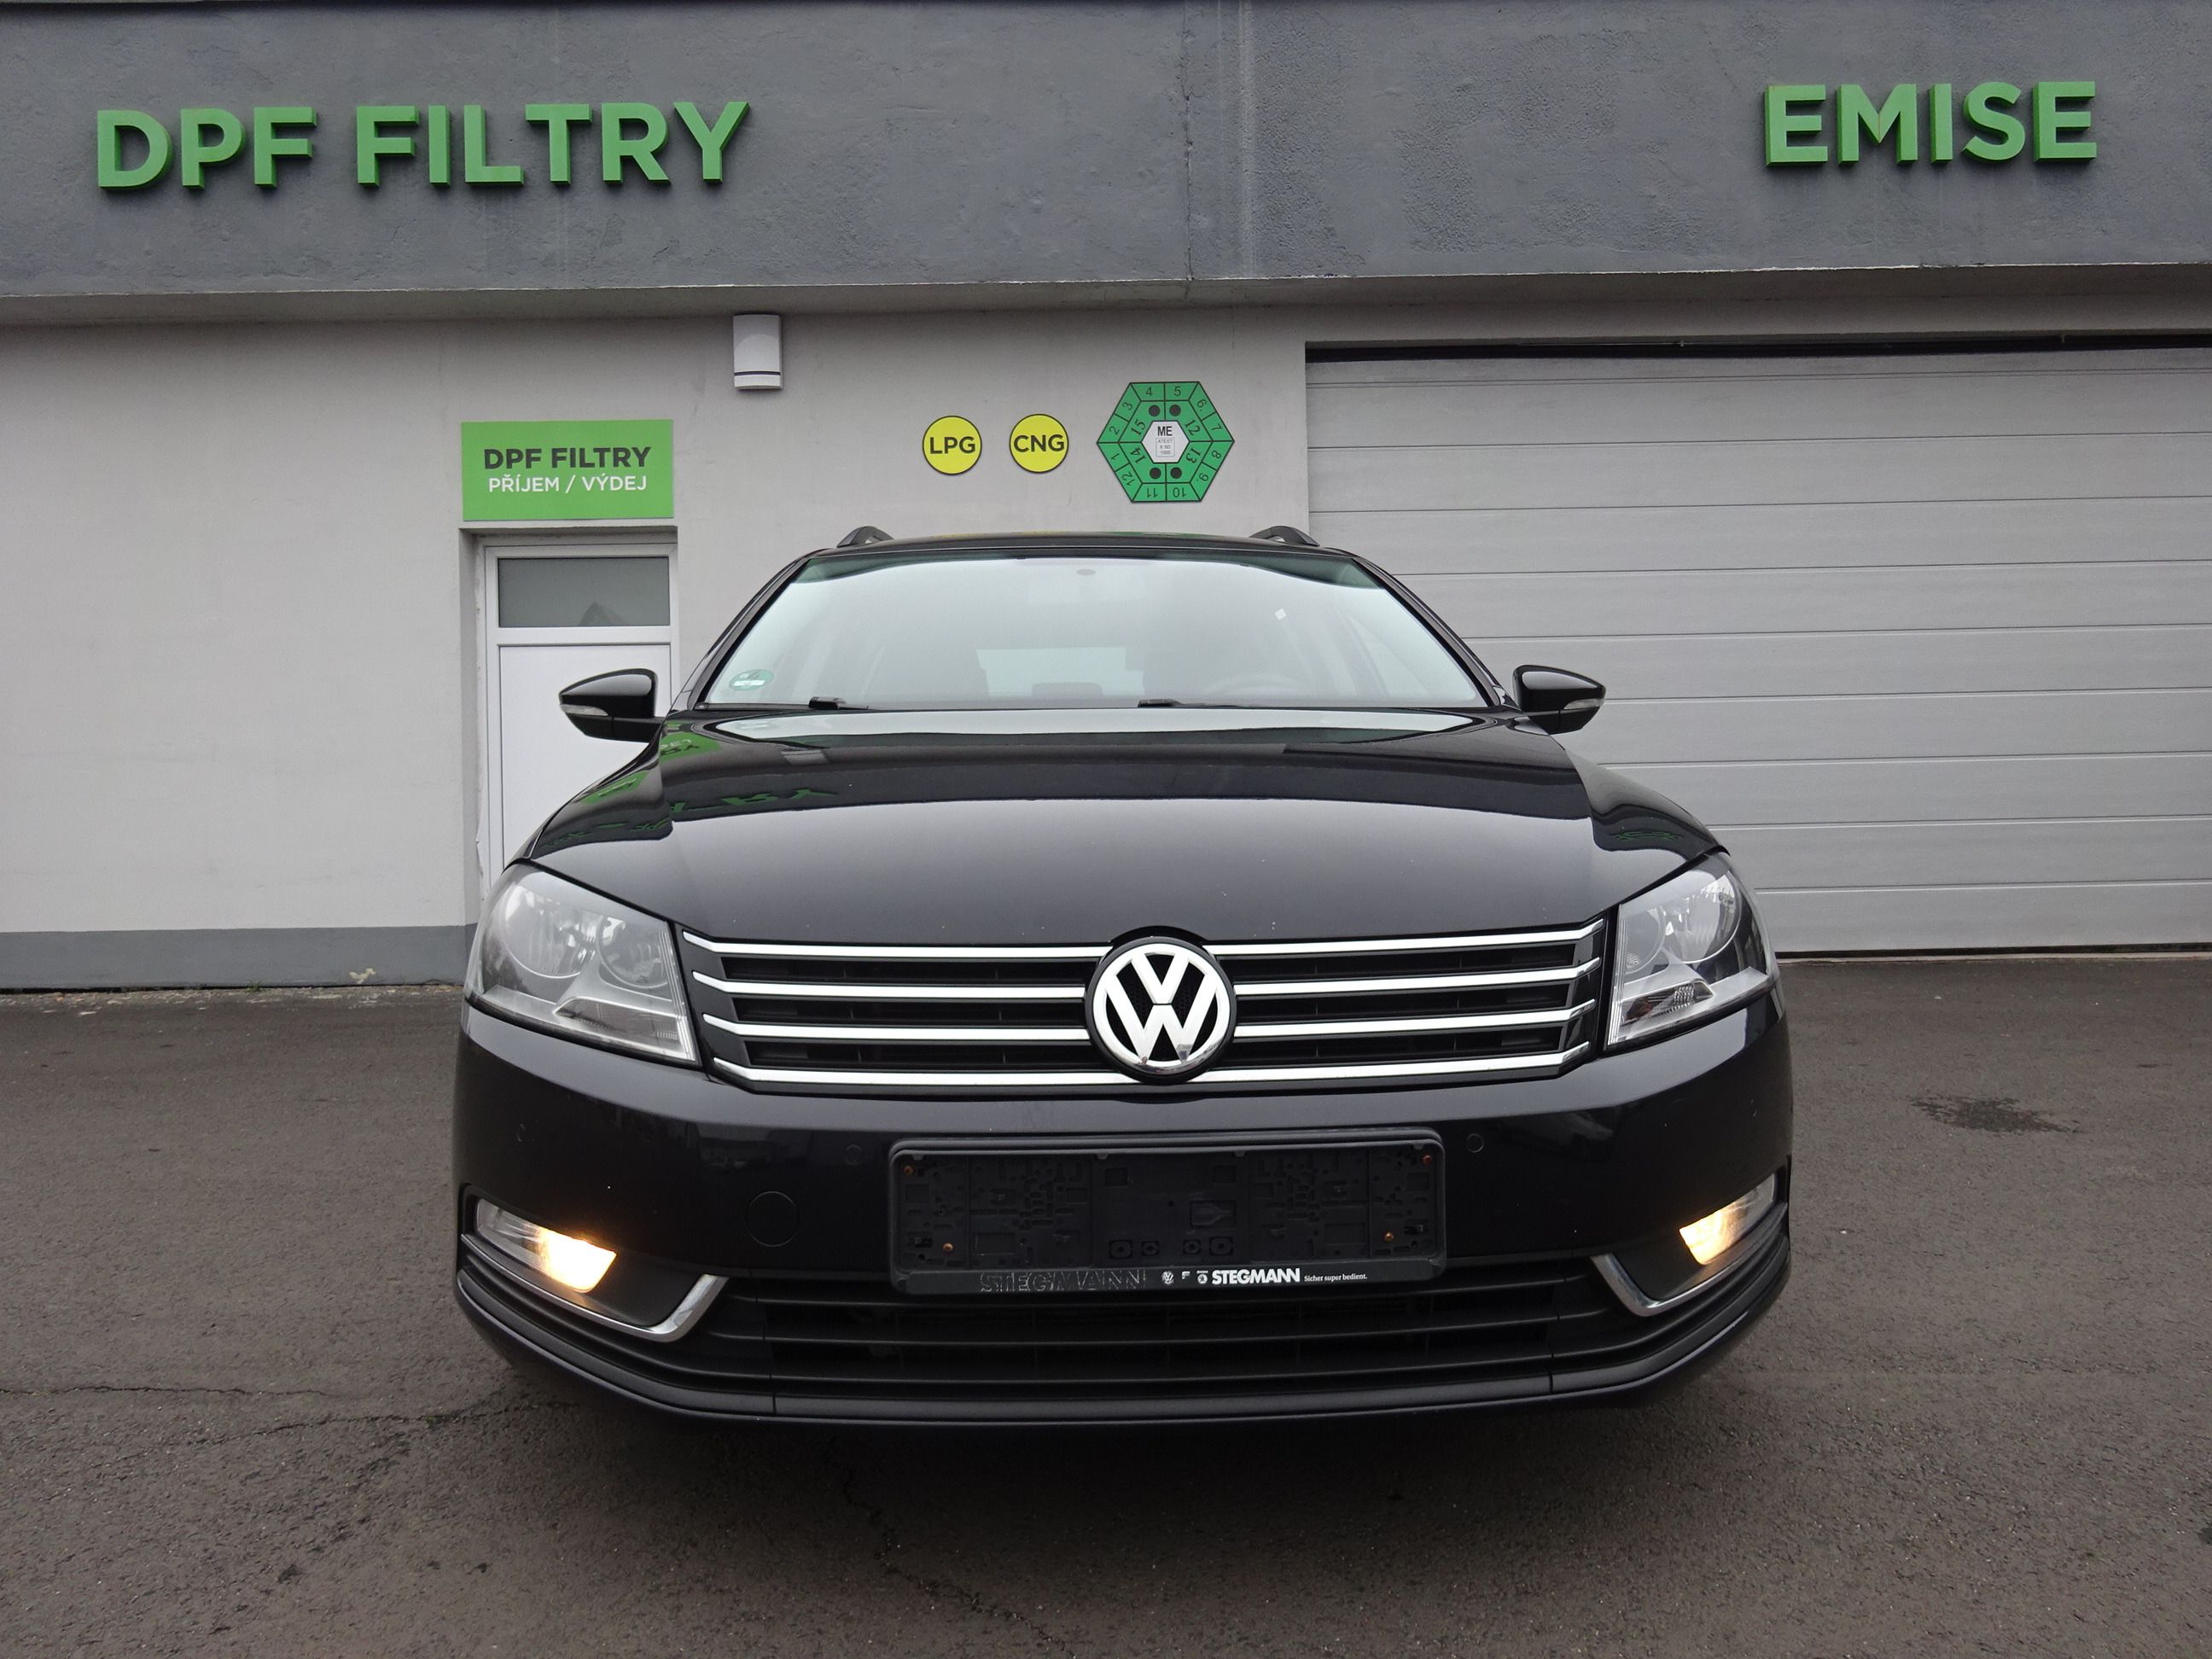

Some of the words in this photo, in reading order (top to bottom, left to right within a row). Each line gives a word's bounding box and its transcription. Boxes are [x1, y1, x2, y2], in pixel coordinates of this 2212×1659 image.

[1764, 81, 2098, 166] EMISE
[96, 106, 317, 189] DPF
[356, 101, 750, 187] FILTRY
[1145, 387, 1153, 396] 4
[1174, 386, 1181, 396] 5
[1122, 402, 1133, 410] 3
[1109, 426, 1120, 436] 2
[1131, 419, 1146, 436] 15
[1157, 426, 1173, 436] ME
[1185, 419, 1201, 436] 12
[1211, 423, 1222, 432] 7
[929, 436, 976, 454] LPG
[1014, 434, 1065, 452] CNG
[484, 448, 542, 469] DPF
[551, 446, 651, 468] FILTRY
[1130, 446, 1146, 464] 14
[1185, 447, 1202, 464] 13
[1211, 451, 1222, 459] 8
[488, 474, 560, 492] PŘÍJEM
[582, 473, 647, 491] VÝDEJ
[1121, 471, 1136, 486] 12
[1146, 487, 1158, 498] 11
[1173, 487, 1186, 498] 10
[1212, 1268, 1301, 1284] STEGMANN
